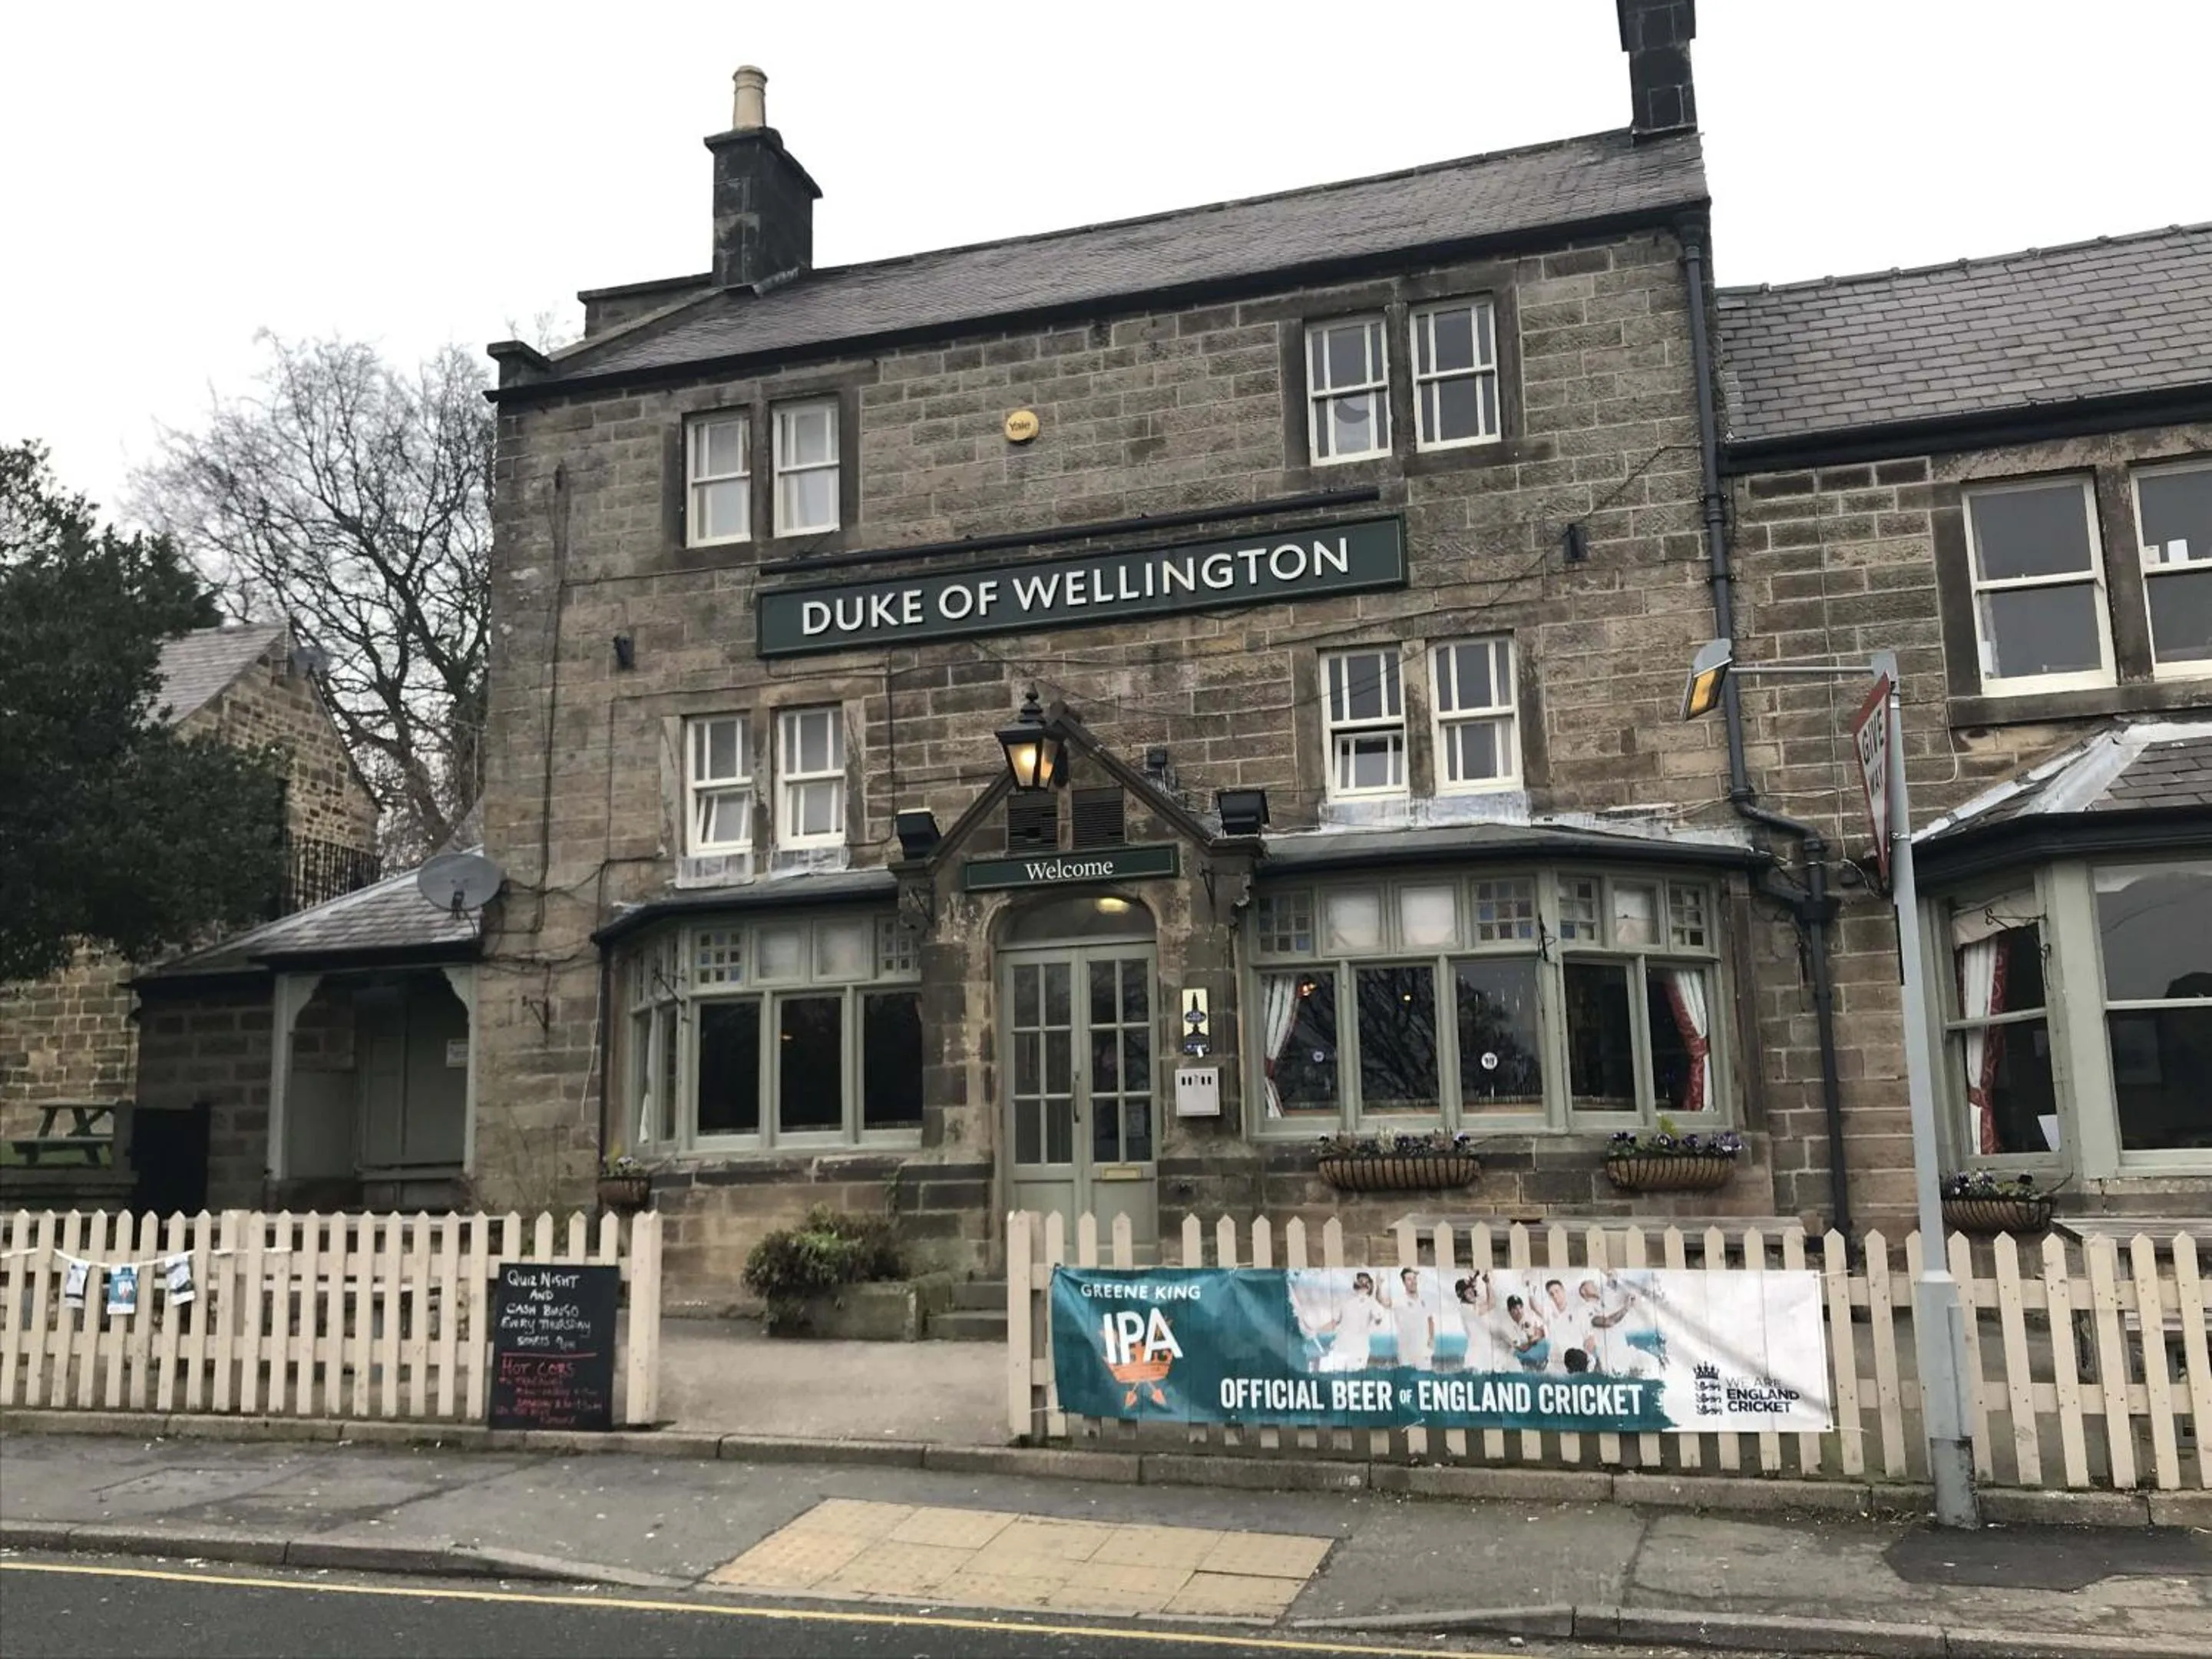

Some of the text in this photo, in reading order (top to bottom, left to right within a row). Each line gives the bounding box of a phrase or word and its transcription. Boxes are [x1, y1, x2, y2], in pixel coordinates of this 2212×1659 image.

[800, 537, 1350, 635] DUKE OF WELLINGTON
[1862, 709, 1884, 765] GIVE
[1868, 761, 1883, 799] WAY
[1023, 859, 1113, 881] Welcome
[529, 1289, 554, 1301] AND
[1080, 1284, 1202, 1300] GREENE KING
[506, 1303, 537, 1315] CASH
[1102, 1307, 1183, 1365] IPA
[1725, 1376, 1781, 1388] WE ARE
[1219, 1377, 1643, 1416] OFFICIAL BEER OF ENGLAND CRICKET
[1726, 1388, 1800, 1400] ENGLAND
[1728, 1400, 1792, 1413] CRICKET
